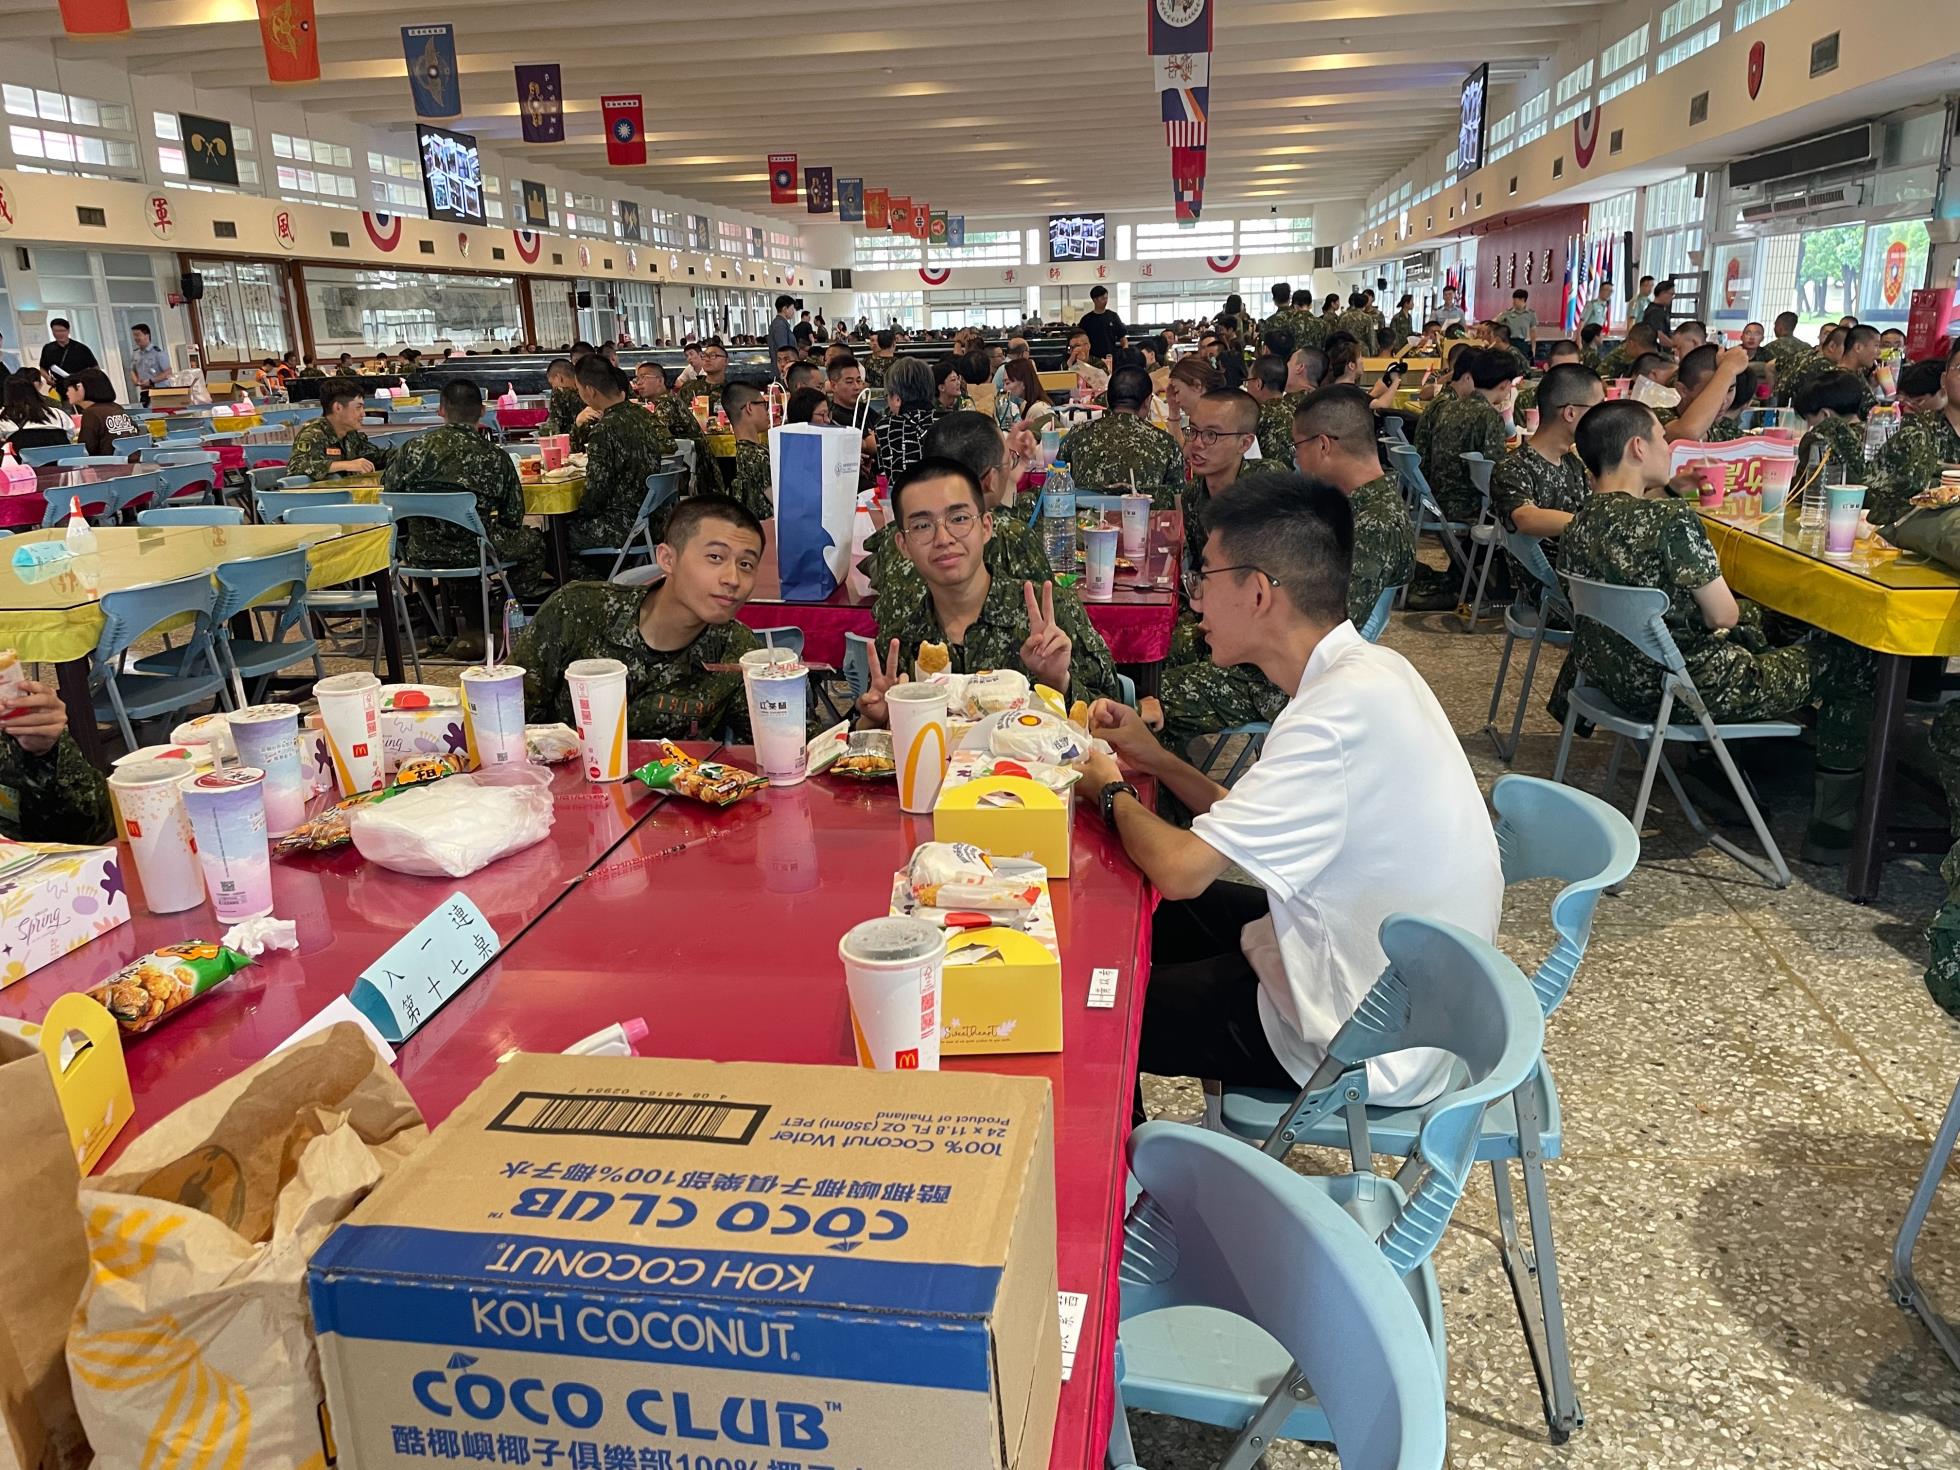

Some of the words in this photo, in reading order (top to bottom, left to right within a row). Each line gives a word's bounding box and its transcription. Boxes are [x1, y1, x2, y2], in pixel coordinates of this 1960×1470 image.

[152, 197, 173, 233] 軍
[276, 211, 296, 243] 風
[17, 907, 71, 946] Spring
[402, 933, 493, 1027] 第十七桌
[943, 1025, 999, 1040] Sweetheart
[781, 1116, 816, 1128] PET
[820, 1118, 879, 1132] (350ml)
[876, 1111, 935, 1122] Thailand
[938, 1115, 952, 1124] of
[973, 1116, 1011, 1127] Product
[881, 1122, 907, 1133] OZ
[911, 1123, 932, 1134] FL
[935, 1125, 967, 1136] 11.8
[988, 1127, 1007, 1138] 24
[769, 1128, 836, 1147] Water
[842, 1134, 935, 1153] Coconut
[945, 1139, 1003, 1156] 100%
[510, 1187, 699, 1229] CLUB
[715, 1200, 910, 1241] COCO
[484, 1243, 706, 1286] COCONUT
[712, 1260, 815, 1294] KOH
[471, 1297, 565, 1341] KOH
[575, 1309, 795, 1361] COCONUT
[412, 1370, 604, 1429] COCO
[625, 1388, 830, 1450] CLUB
